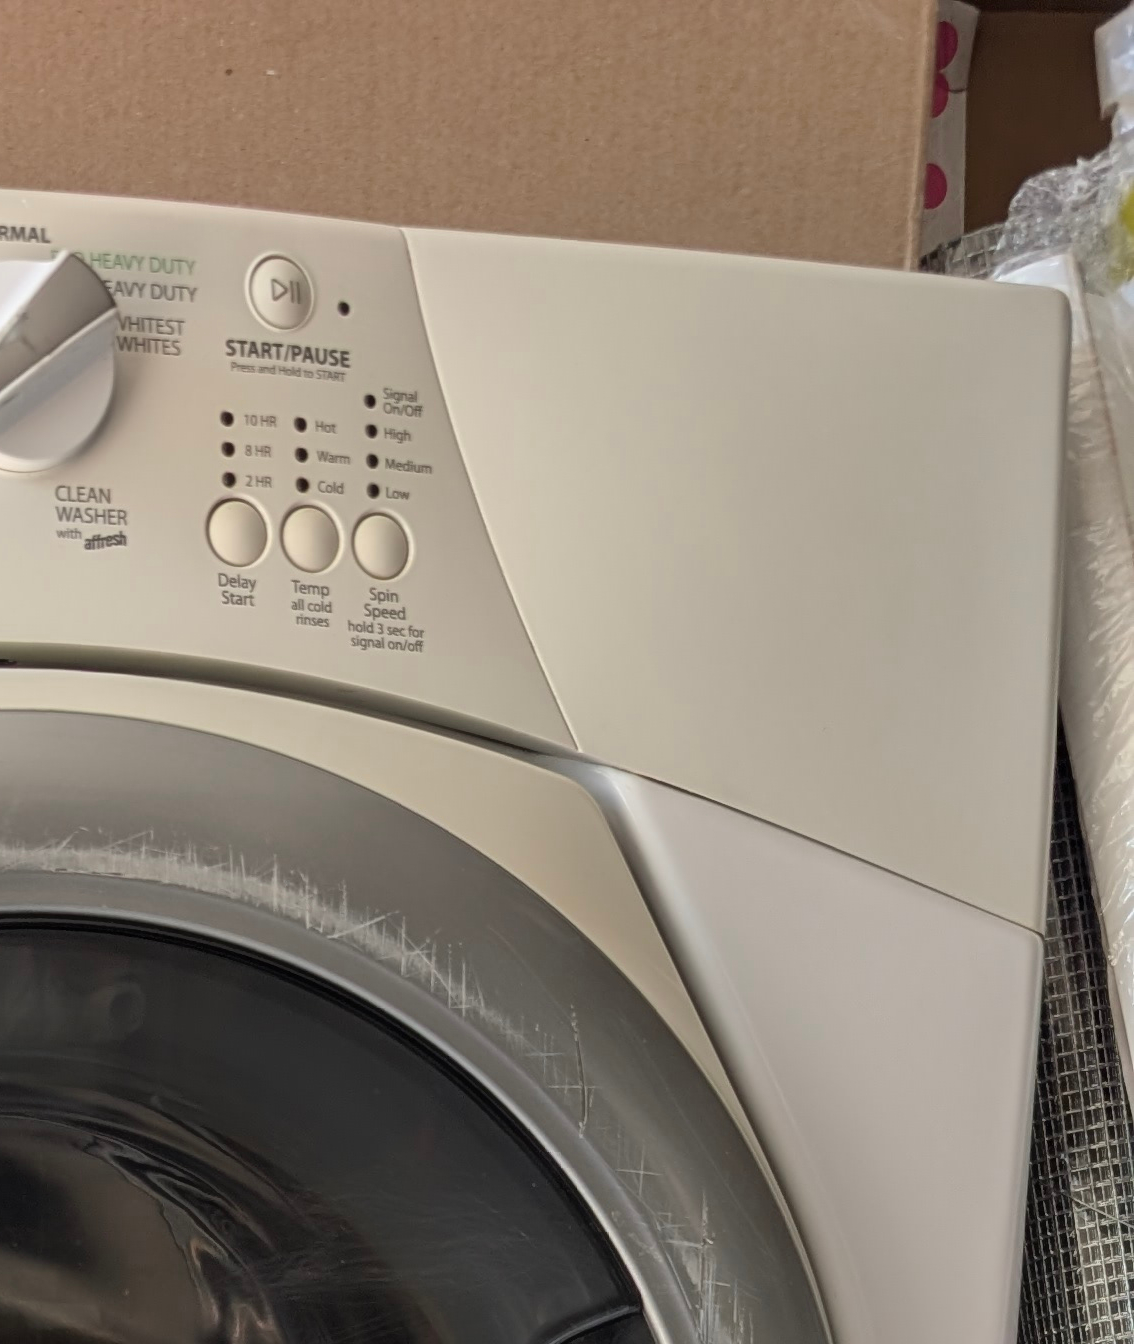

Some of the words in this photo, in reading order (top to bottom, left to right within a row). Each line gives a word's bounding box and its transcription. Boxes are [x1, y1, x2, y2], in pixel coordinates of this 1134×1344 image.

[90, 252, 145, 271] HEAVY
[150, 257, 196, 275] DUTY
[103, 280, 146, 298] EAVY
[151, 284, 198, 302] DUTY
[116, 336, 180, 356] WHITES
[226, 339, 350, 368] START/PAUSE
[231, 362, 255, 373] Press
[258, 364, 276, 375] and
[279, 365, 301, 377] Hold
[304, 369, 313, 378] to
[316, 370, 346, 382] START
[383, 388, 417, 404] Signal
[383, 403, 423, 417] On/Off
[245, 414, 257, 426] 10
[260, 415, 276, 427] HR
[315, 420, 337, 433] Hot
[384, 428, 411, 443] High
[245, 444, 252, 456] 8
[255, 446, 271, 458] HR
[317, 452, 350, 465] Warm
[385, 458, 432, 474] Medium
[245, 475, 253, 488] 2
[255, 476, 272, 489] HR
[318, 482, 343, 495] Cold
[55, 485, 111, 504] CLEAN
[386, 488, 409, 500] Low
[55, 506, 127, 526] WASHER
[56, 528, 82, 540] with
[84, 531, 127, 550] affresh
[218, 573, 256, 592] Delay
[292, 580, 330, 598] Temp
[222, 591, 255, 606] Start
[370, 588, 398, 603] Spin
[291, 600, 304, 611] all
[307, 600, 332, 614] cold
[364, 604, 406, 621] Speed
[296, 615, 329, 627] rinses
[348, 621, 374, 634] hold
[377, 624, 384, 635] 3
[387, 626, 406, 637] sec
[409, 626, 424, 639] for
[351, 636, 387, 651] signal
[389, 639, 424, 652] on/off
